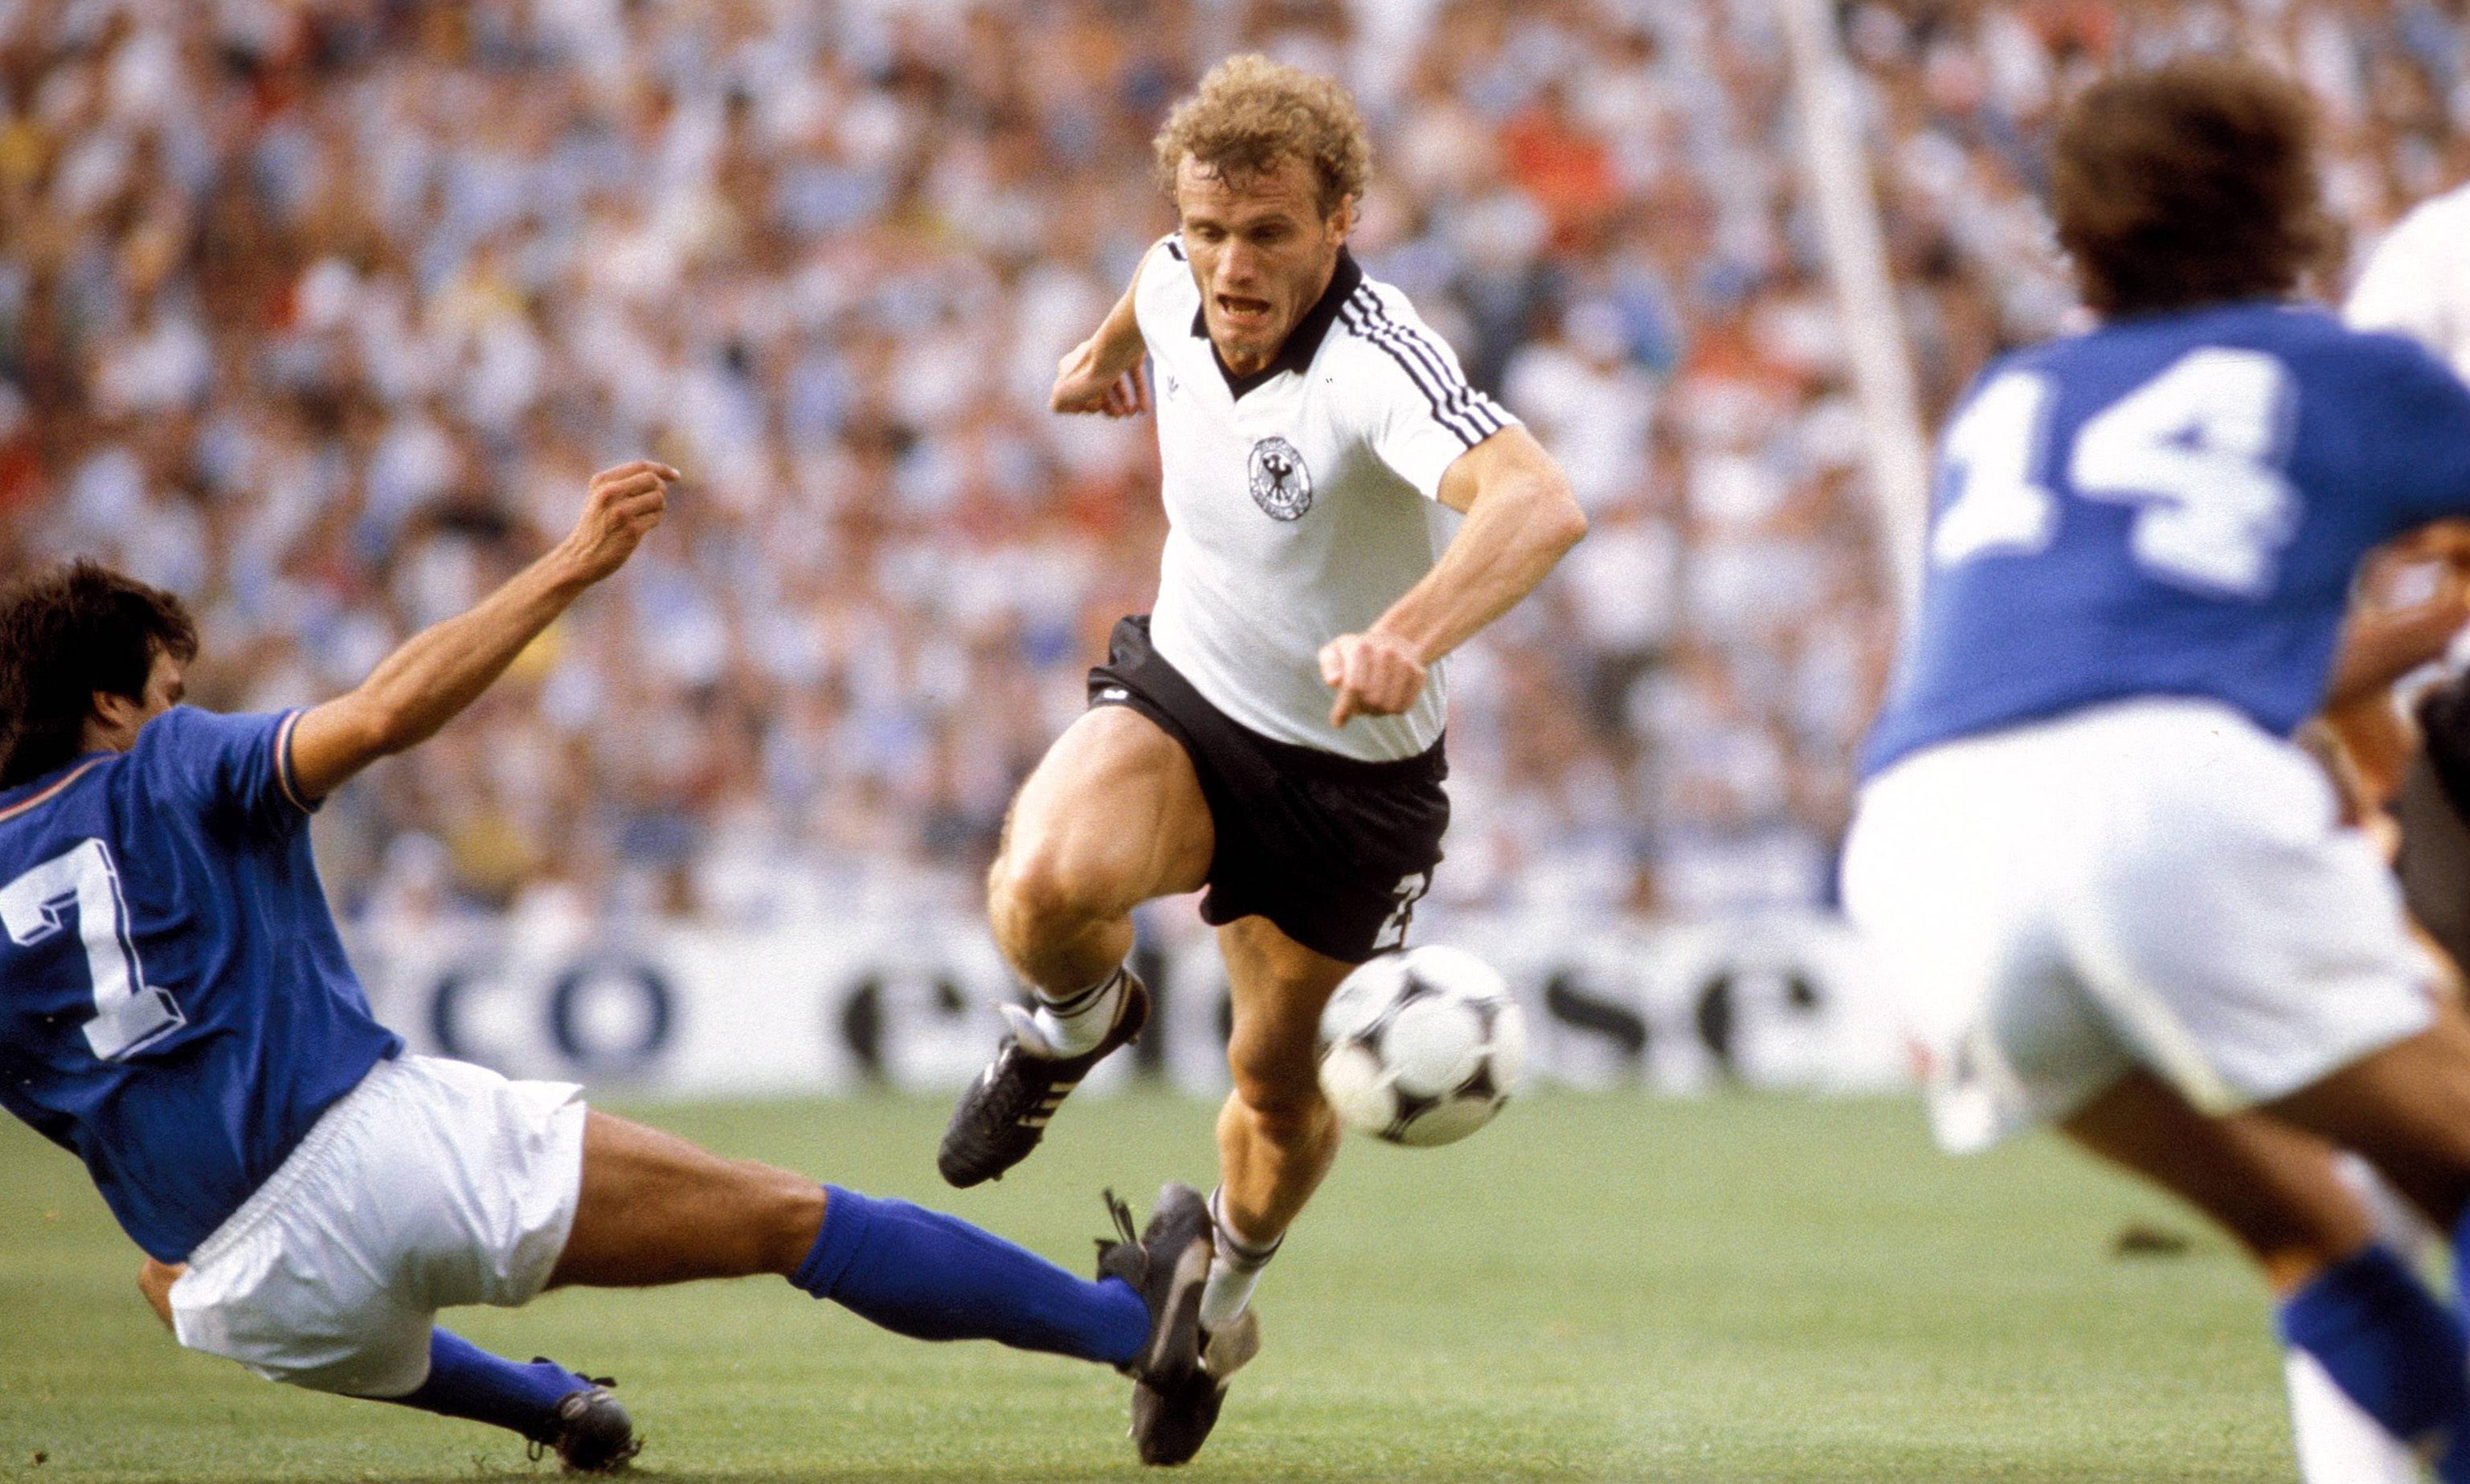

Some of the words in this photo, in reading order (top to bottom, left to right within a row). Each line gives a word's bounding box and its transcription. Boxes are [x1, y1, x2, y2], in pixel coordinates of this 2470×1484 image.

[1931, 345, 2304, 599] 14
[0, 837, 187, 1062] 7
[1371, 872, 1427, 950] 2
